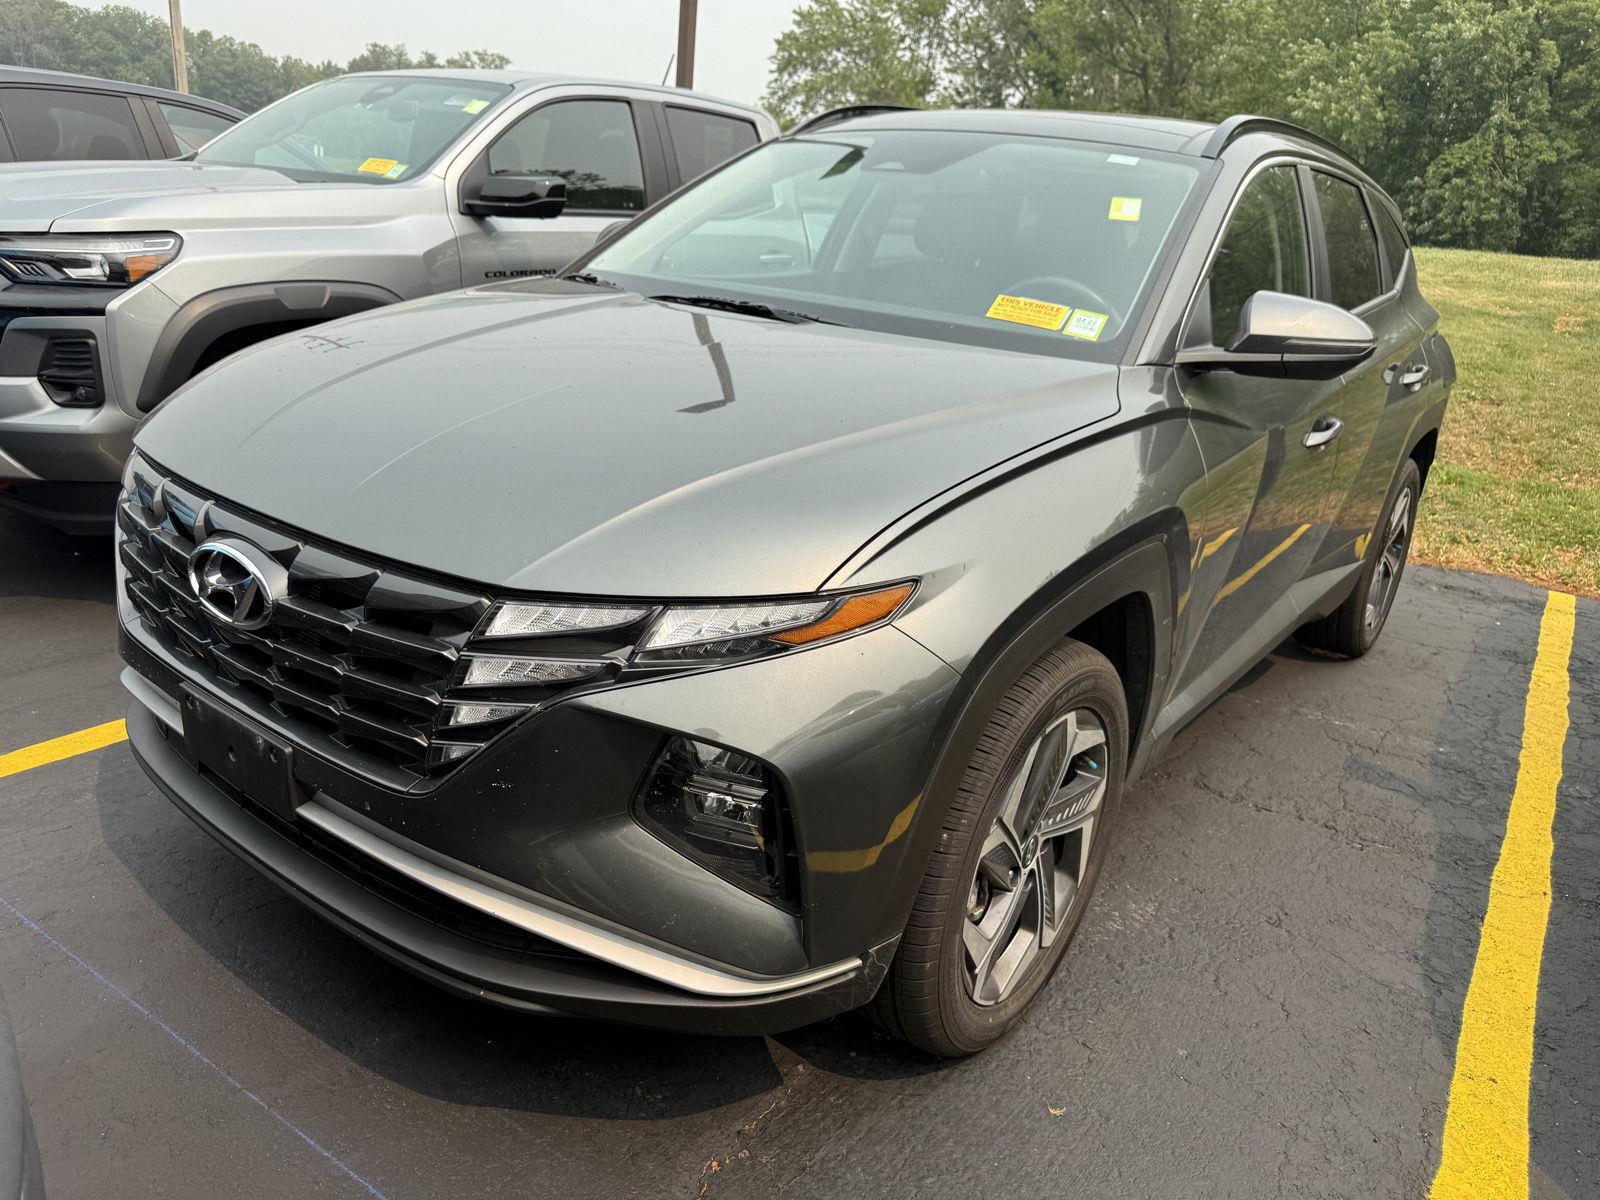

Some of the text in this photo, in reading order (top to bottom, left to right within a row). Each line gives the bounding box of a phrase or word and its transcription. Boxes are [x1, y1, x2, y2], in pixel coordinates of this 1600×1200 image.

[484, 268, 556, 278] COLORADO
[1001, 296, 1062, 313] THIS VEHICLE
[1043, 310, 1059, 318] SALE
